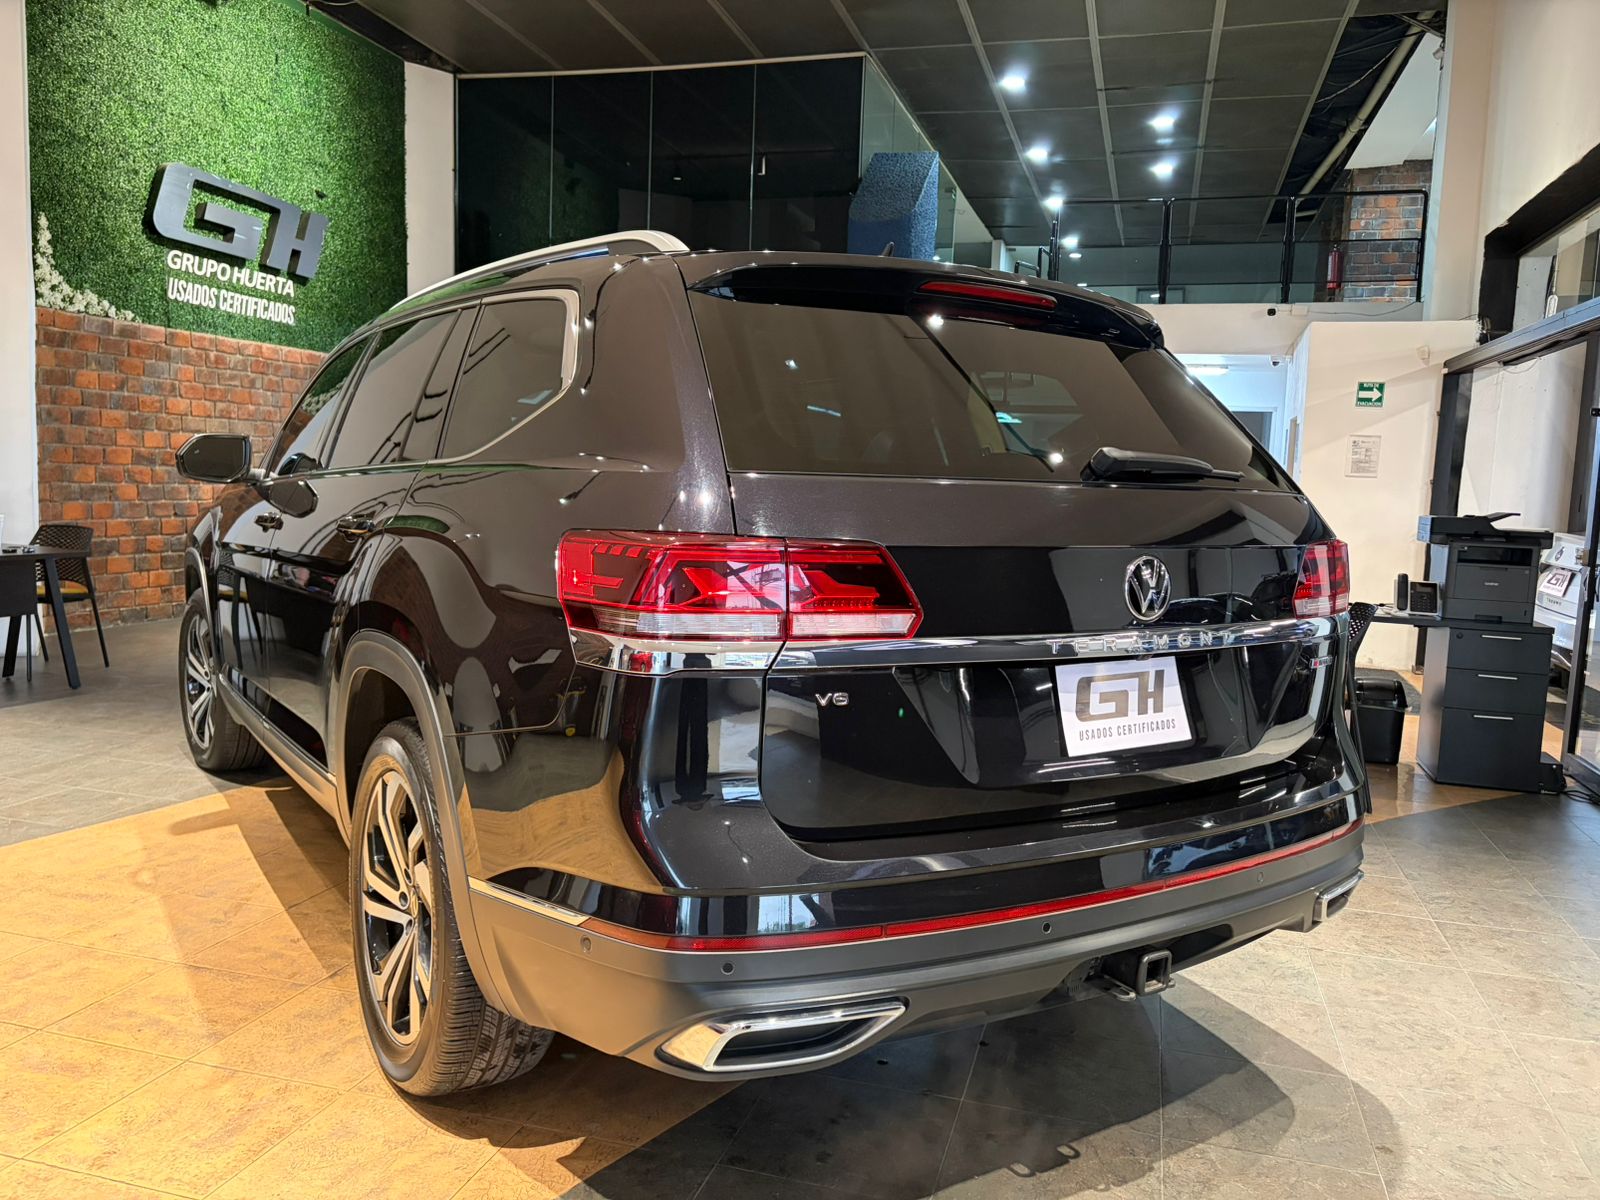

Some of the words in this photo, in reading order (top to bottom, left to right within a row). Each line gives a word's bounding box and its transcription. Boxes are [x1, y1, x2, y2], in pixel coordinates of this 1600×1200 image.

[167, 250, 231, 281] GRUPO
[232, 266, 295, 298] HUERTA
[167, 277, 218, 309] USADOS
[219, 289, 296, 326] CERTIFICADOS
[1046, 630, 1236, 655] TERAMONT
[815, 692, 849, 707] V6
[1075, 669, 1165, 723] GH
[1079, 726, 1113, 741] USADOS
[1117, 718, 1176, 736] CERTIFICADOS
